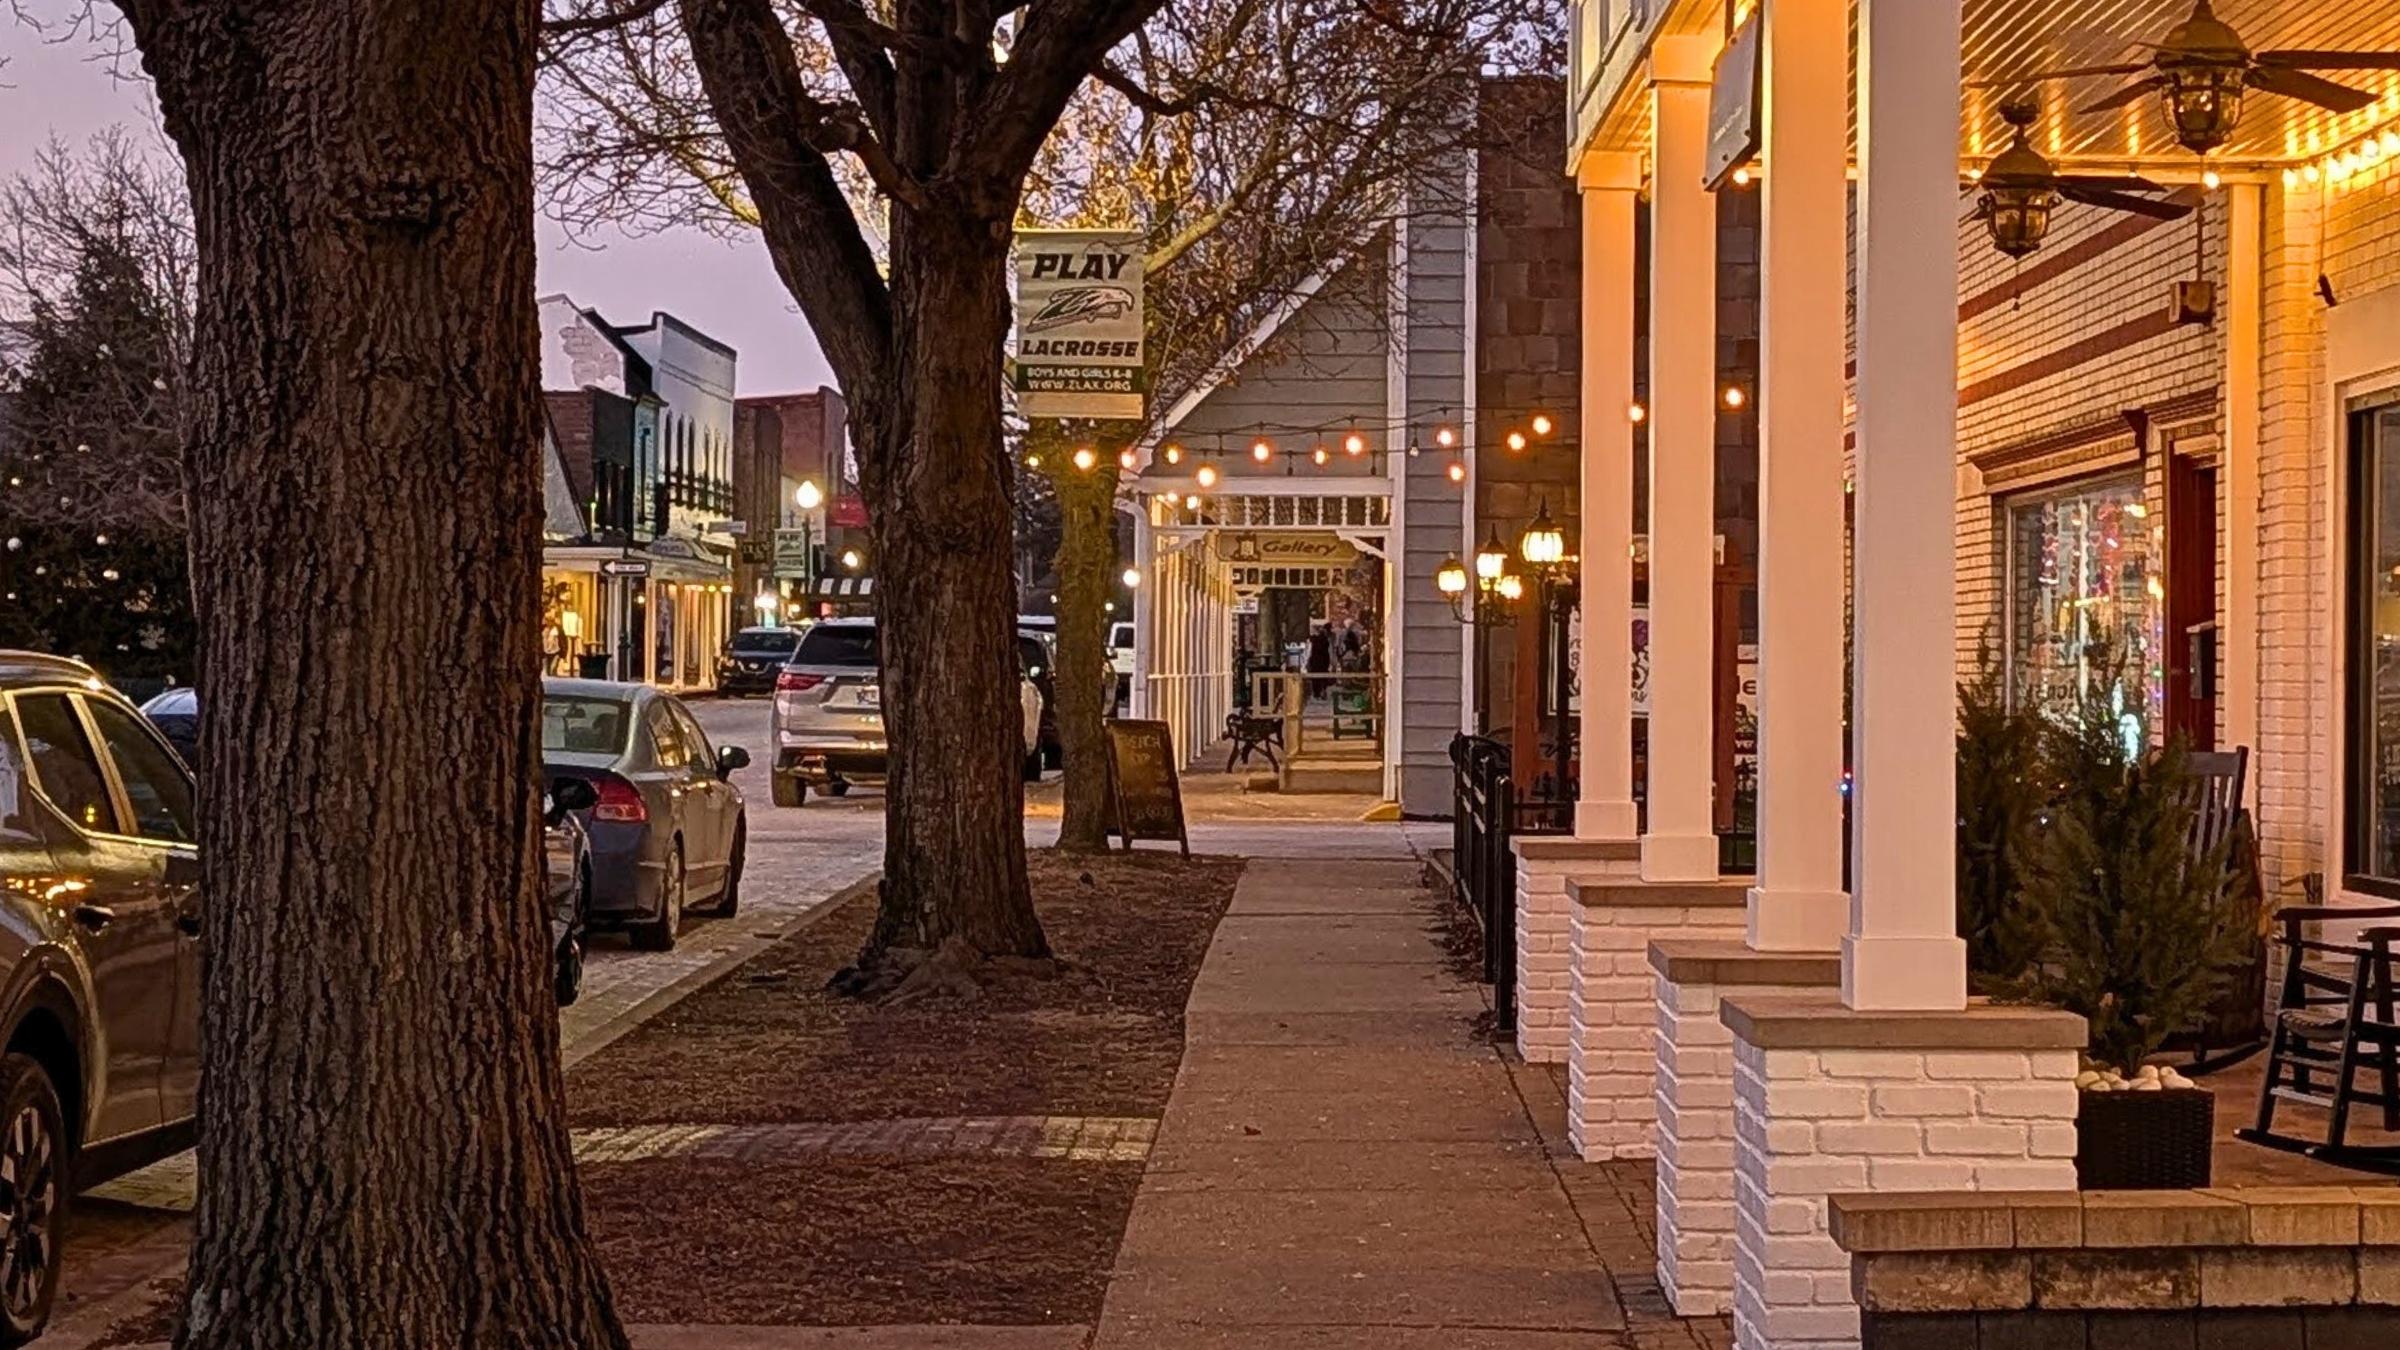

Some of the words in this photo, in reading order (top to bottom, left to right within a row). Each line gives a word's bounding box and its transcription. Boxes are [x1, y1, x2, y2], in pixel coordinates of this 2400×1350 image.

[1032, 253, 1131, 280] PLAY
[1021, 339, 1139, 357] LACROSSE
[1027, 367, 1055, 378] BOYS
[1056, 368, 1080, 378] AND
[1081, 368, 1112, 379] GIRLS
[1027, 380, 1132, 391] WWW.ZLAX.ORG
[1262, 540, 1338, 556] Gallery
